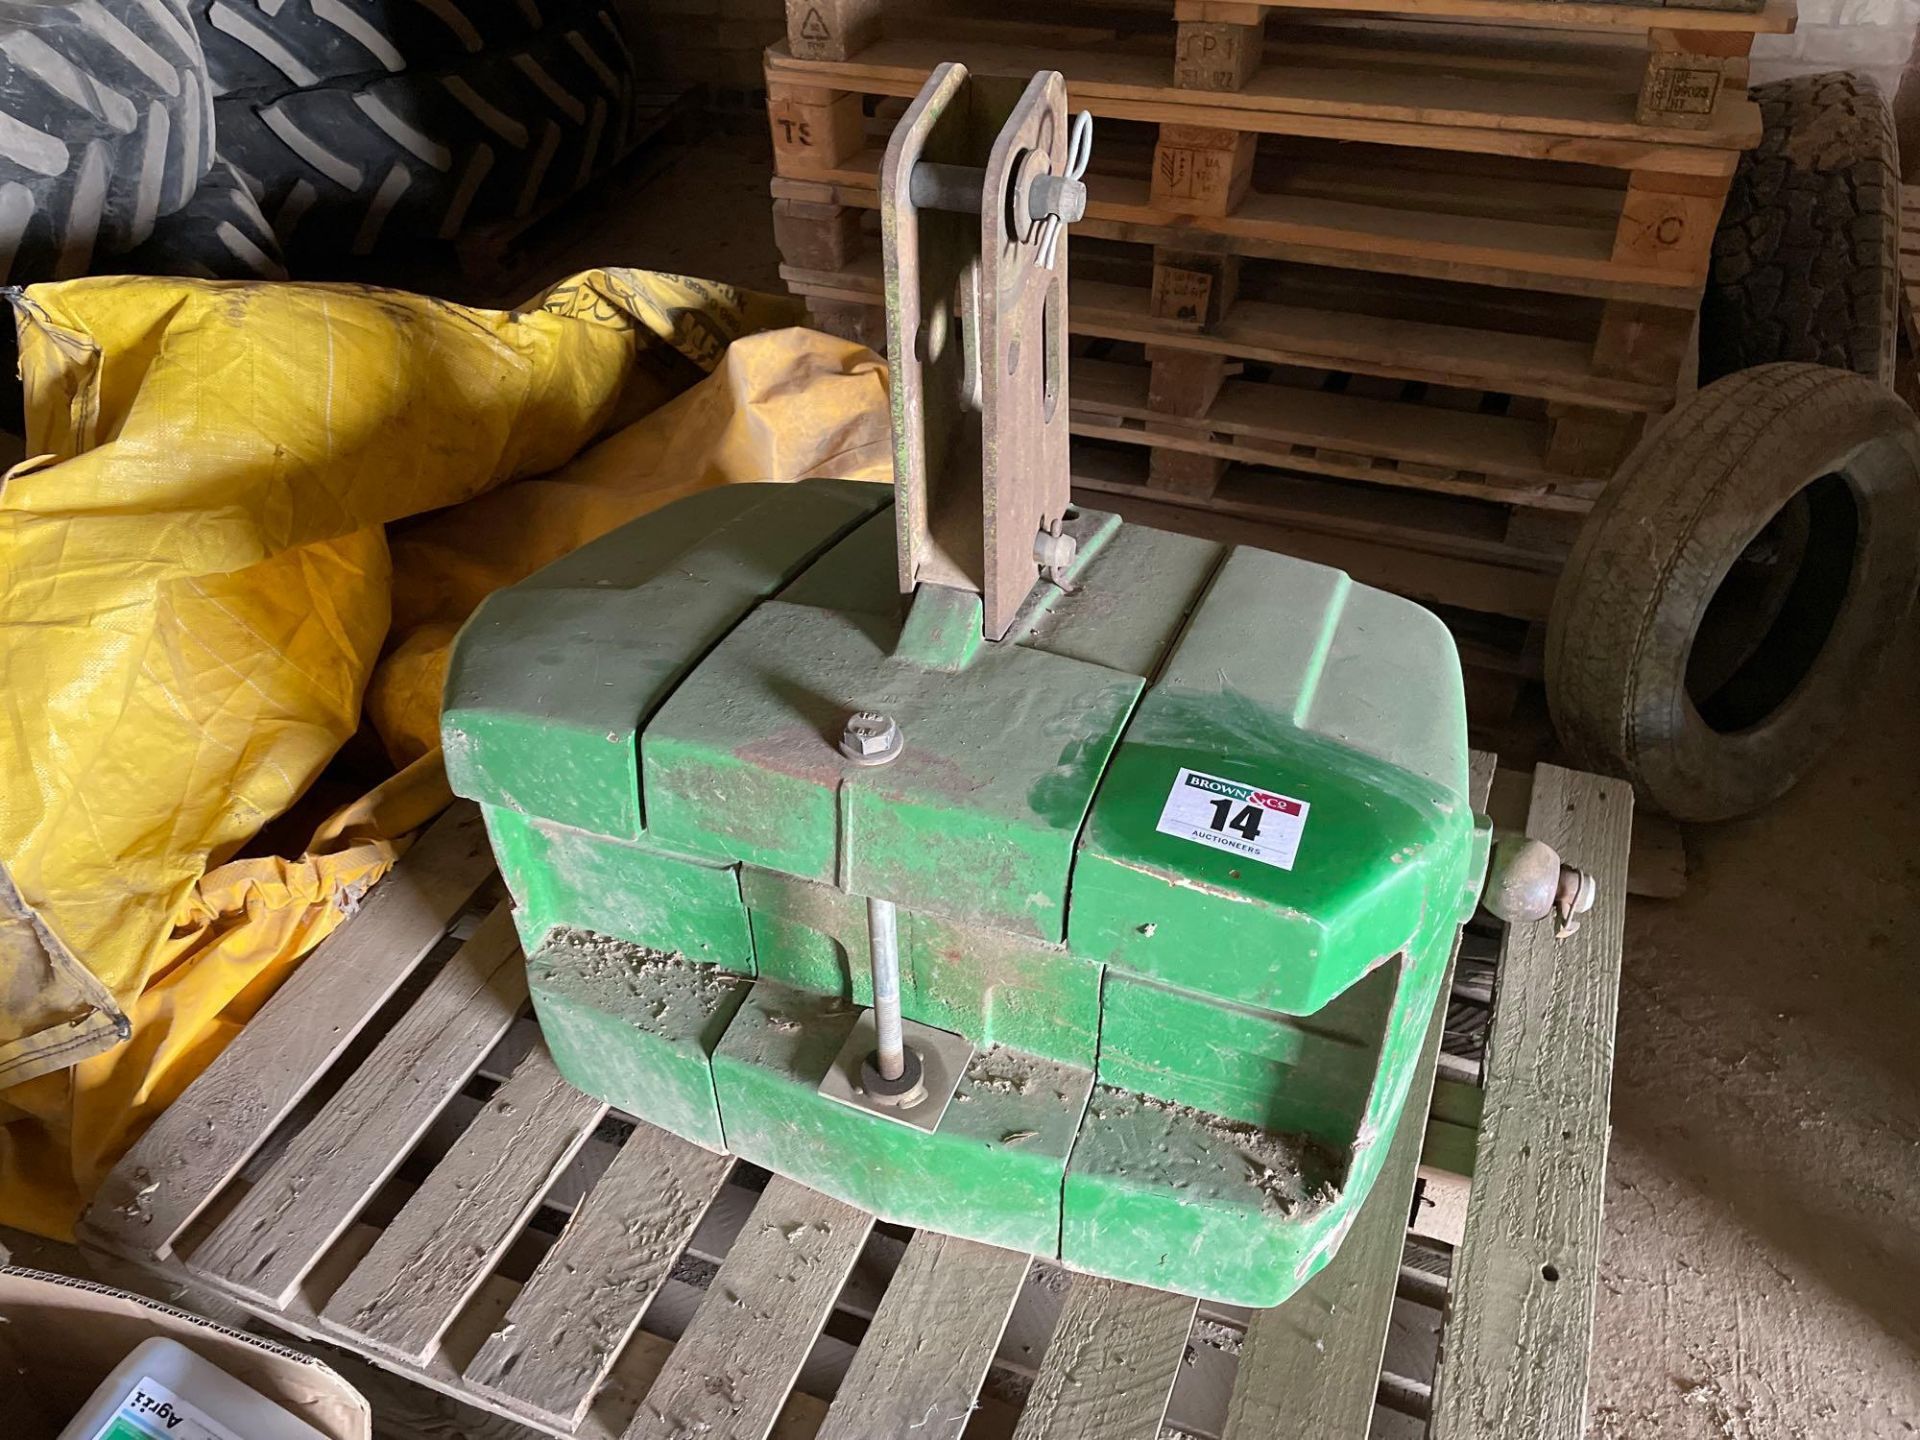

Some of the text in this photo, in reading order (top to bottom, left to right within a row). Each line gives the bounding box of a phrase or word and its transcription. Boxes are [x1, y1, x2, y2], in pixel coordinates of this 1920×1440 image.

[1209, 798, 1264, 842] 14
[1192, 830, 1261, 855] AUCTIONEERS
[130, 1391, 184, 1429] Agrii
